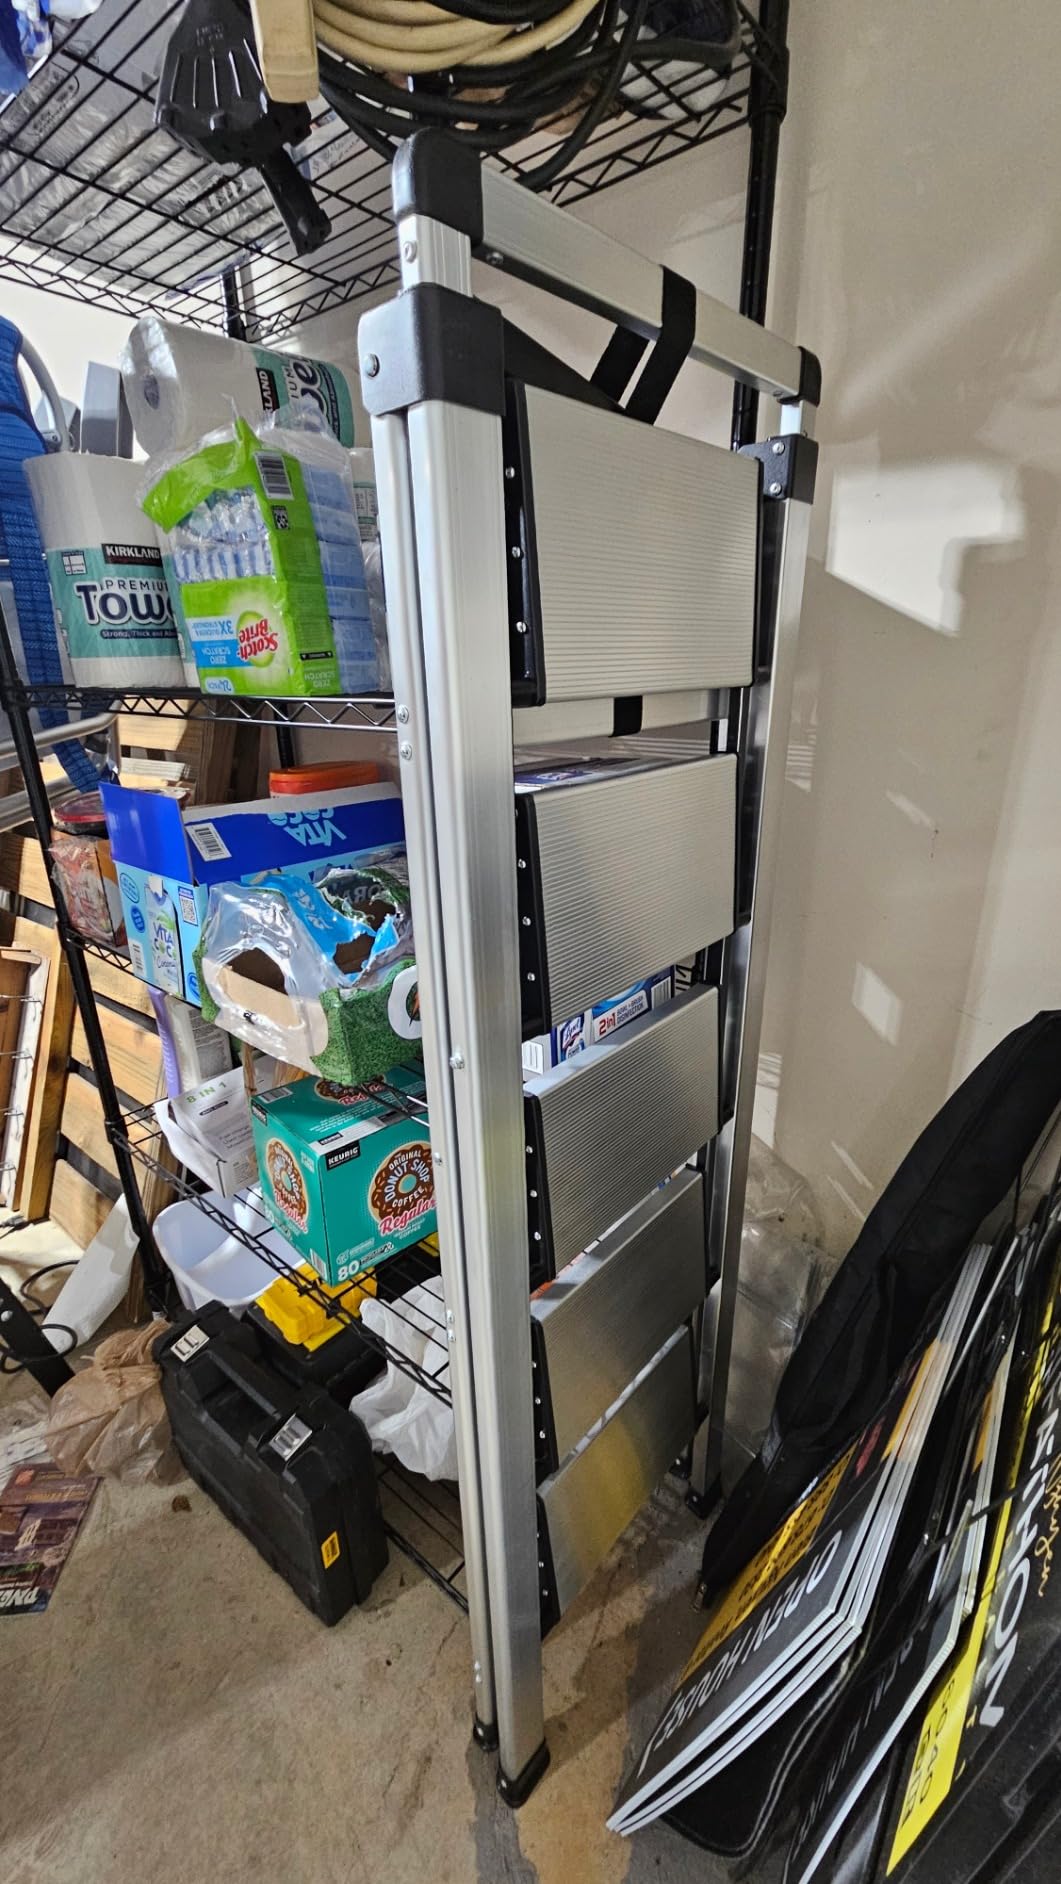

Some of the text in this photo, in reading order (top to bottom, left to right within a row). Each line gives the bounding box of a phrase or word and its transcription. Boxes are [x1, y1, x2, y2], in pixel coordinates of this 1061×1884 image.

[105, 545, 160, 559] KIRKLAND
[220, 620, 233, 635] 3X
[239, 619, 268, 643] Brite
[283, 820, 347, 847] VITA
[153, 921, 174, 944] VITA
[199, 1086, 216, 1098] IN
[328, 1147, 359, 1166] KEURIG
[389, 1150, 422, 1170] ORIGINAL
[384, 1158, 430, 1202] DONUT SHOP
[392, 1185, 425, 1208] COFFEE
[338, 1260, 360, 1281] 80
[740, 1529, 843, 1666] OPEN
[652, 1639, 742, 1752] HOUSE
